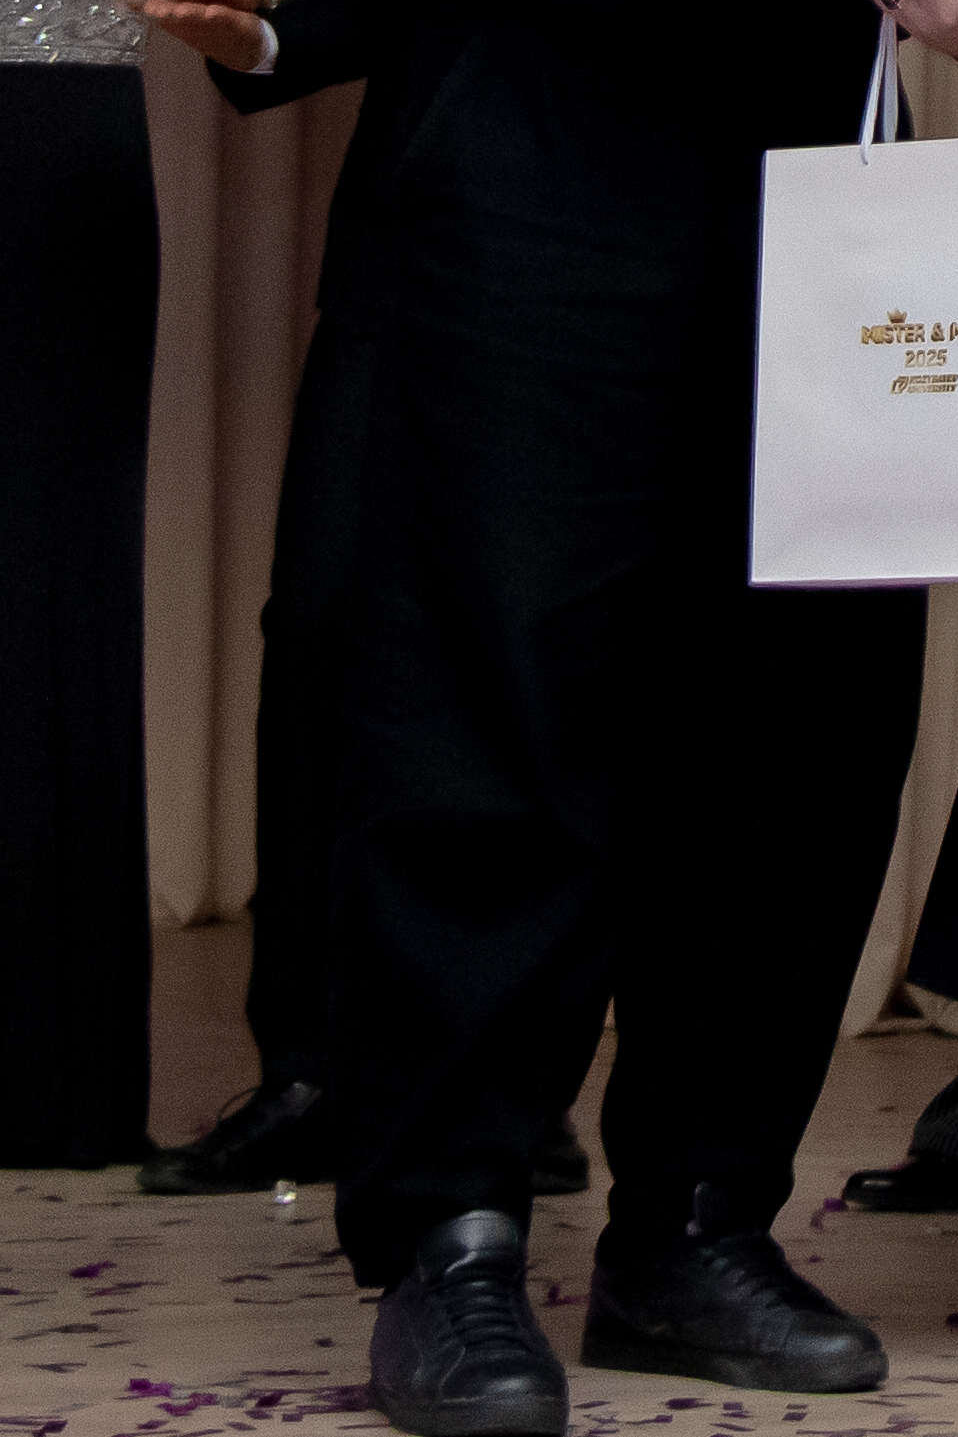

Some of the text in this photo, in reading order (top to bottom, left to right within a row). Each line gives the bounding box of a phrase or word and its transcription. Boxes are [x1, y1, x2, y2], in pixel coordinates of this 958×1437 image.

[861, 323, 925, 345] MISTER
[930, 322, 945, 342] &
[904, 348, 948, 368] 2025
